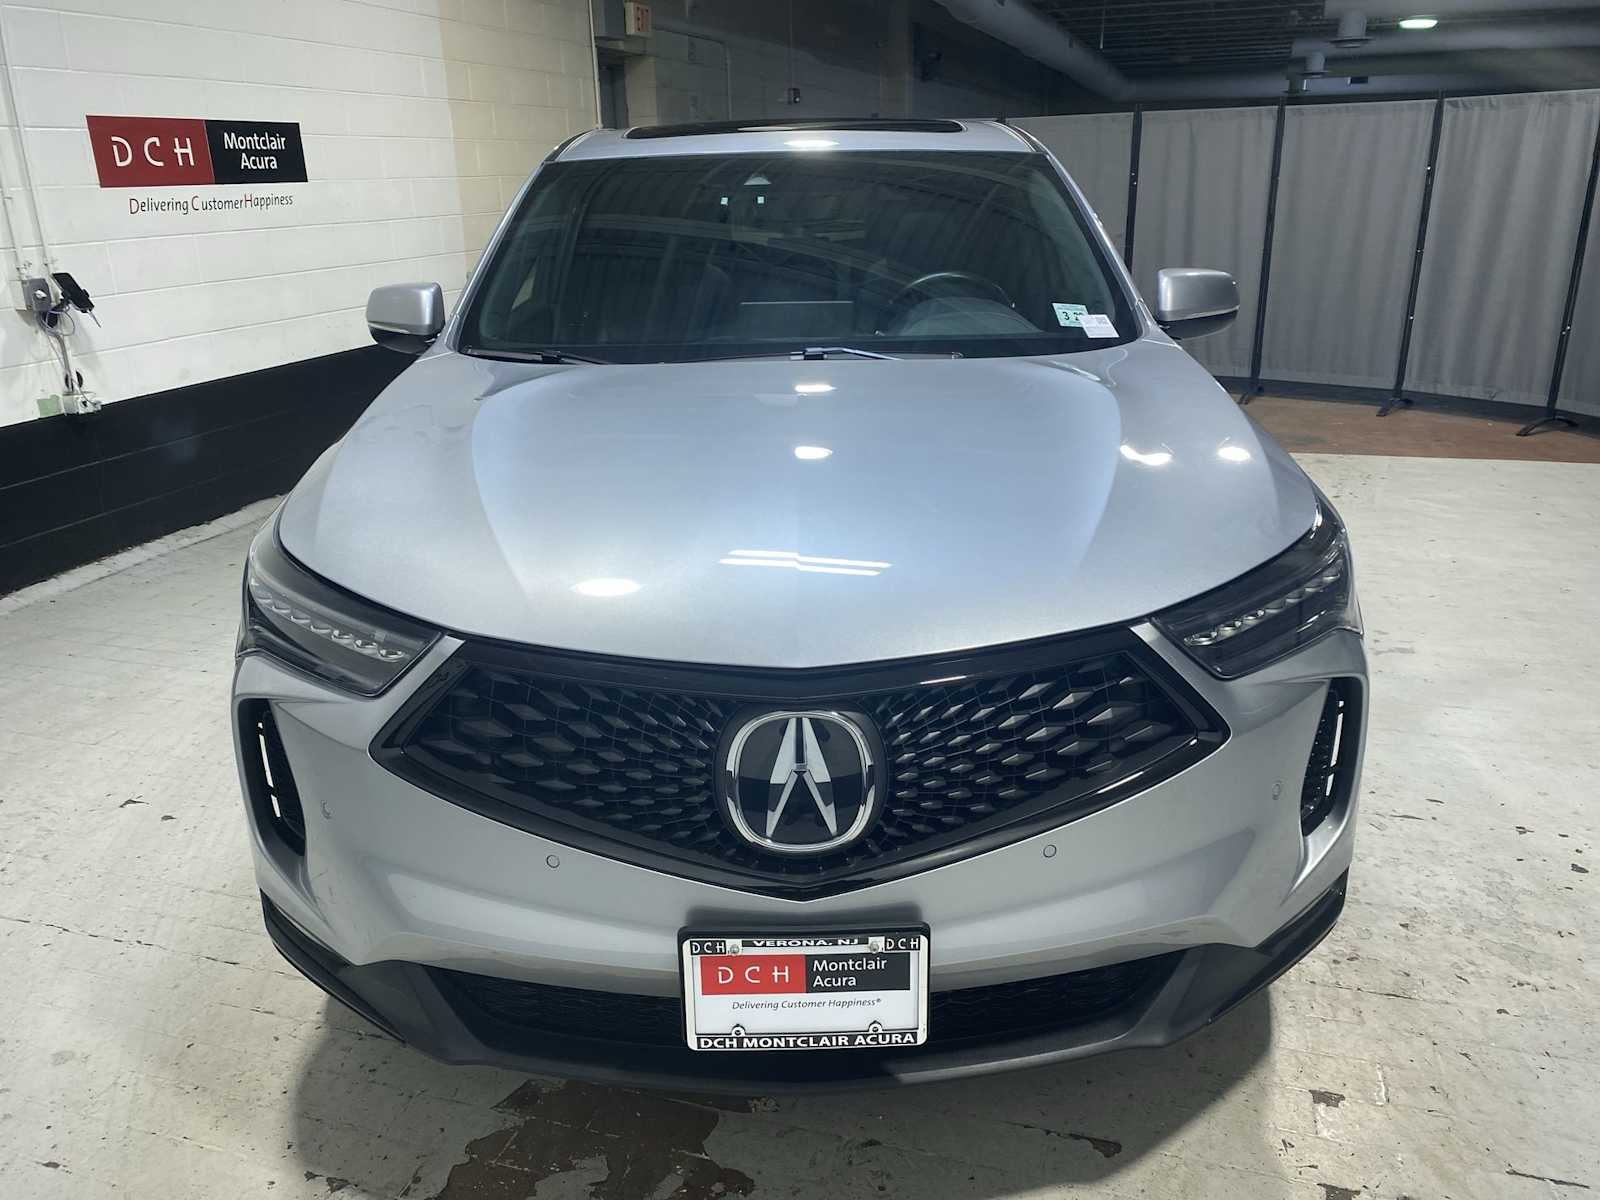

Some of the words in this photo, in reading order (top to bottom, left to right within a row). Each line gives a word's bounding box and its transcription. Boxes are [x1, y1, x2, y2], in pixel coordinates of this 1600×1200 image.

[223, 132, 286, 151] Montclair
[240, 152, 278, 170] Acura
[128, 197, 189, 215] Delivering
[191, 195, 243, 211] Customer
[244, 193, 294, 211] Happiness
[1062, 311, 1070, 321] 3
[692, 941, 725, 954] DCH
[838, 938, 859, 946] NJ
[885, 938, 919, 950] DCH
[813, 957, 887, 972] Montclair
[813, 974, 857, 988] Acura
[732, 1000, 779, 1011] Delivering
[781, 999, 827, 1009] Customer
[700, 1037, 738, 1049] DCH
[742, 1035, 849, 1048] MONTCLAIR
[855, 1032, 915, 1046] ACURA
